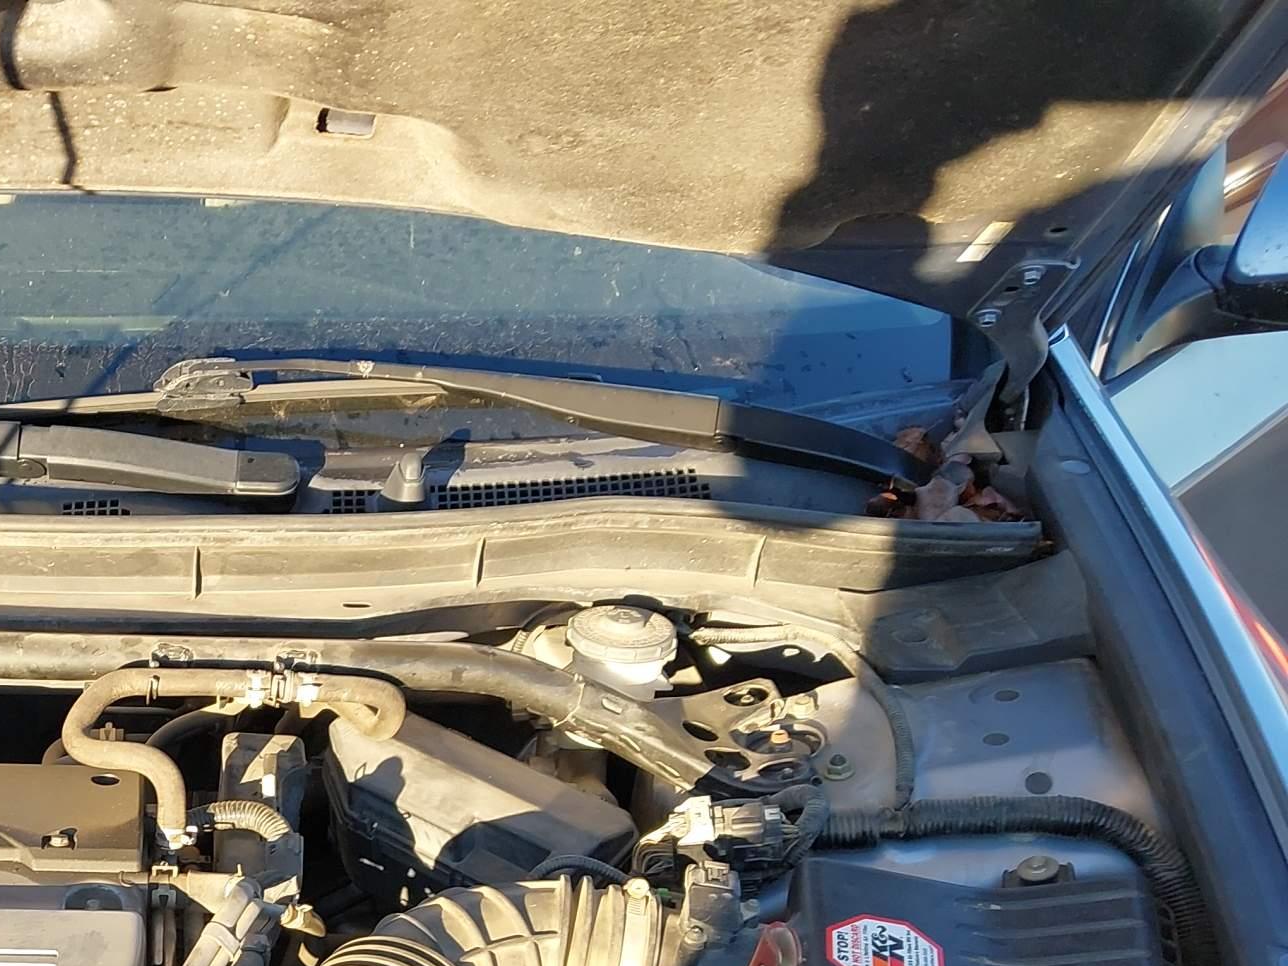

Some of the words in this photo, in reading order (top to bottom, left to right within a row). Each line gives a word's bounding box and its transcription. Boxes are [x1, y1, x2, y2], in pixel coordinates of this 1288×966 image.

[837, 931, 849, 961] STOP!
[851, 924, 860, 949] DISCARD
[872, 925, 904, 963] K&N
[852, 951, 861, 964] NOT
